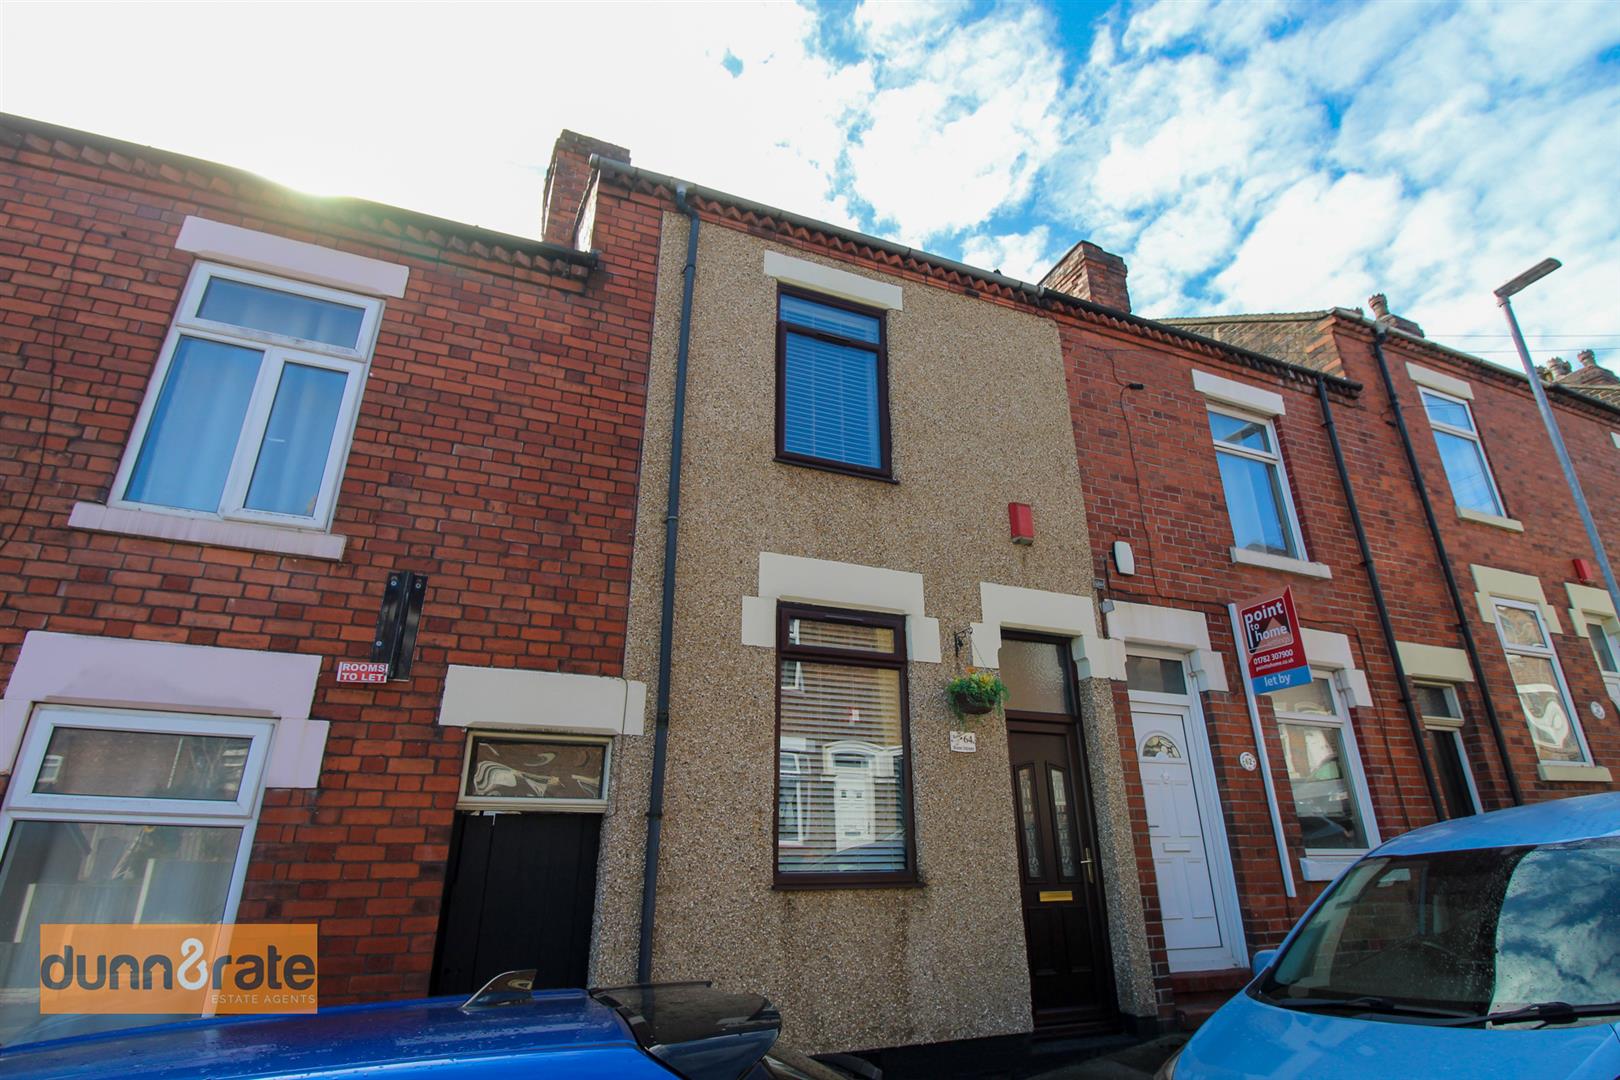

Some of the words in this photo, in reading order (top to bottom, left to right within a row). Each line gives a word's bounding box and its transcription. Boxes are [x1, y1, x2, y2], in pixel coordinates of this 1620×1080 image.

[1250, 623, 1260, 631] to
[1255, 625, 1287, 641] home
[342, 663, 385, 672] ROOMS
[341, 672, 358, 681] TO
[361, 673, 383, 681] LET
[1264, 675, 1278, 687] let
[1279, 673, 1291, 685] by
